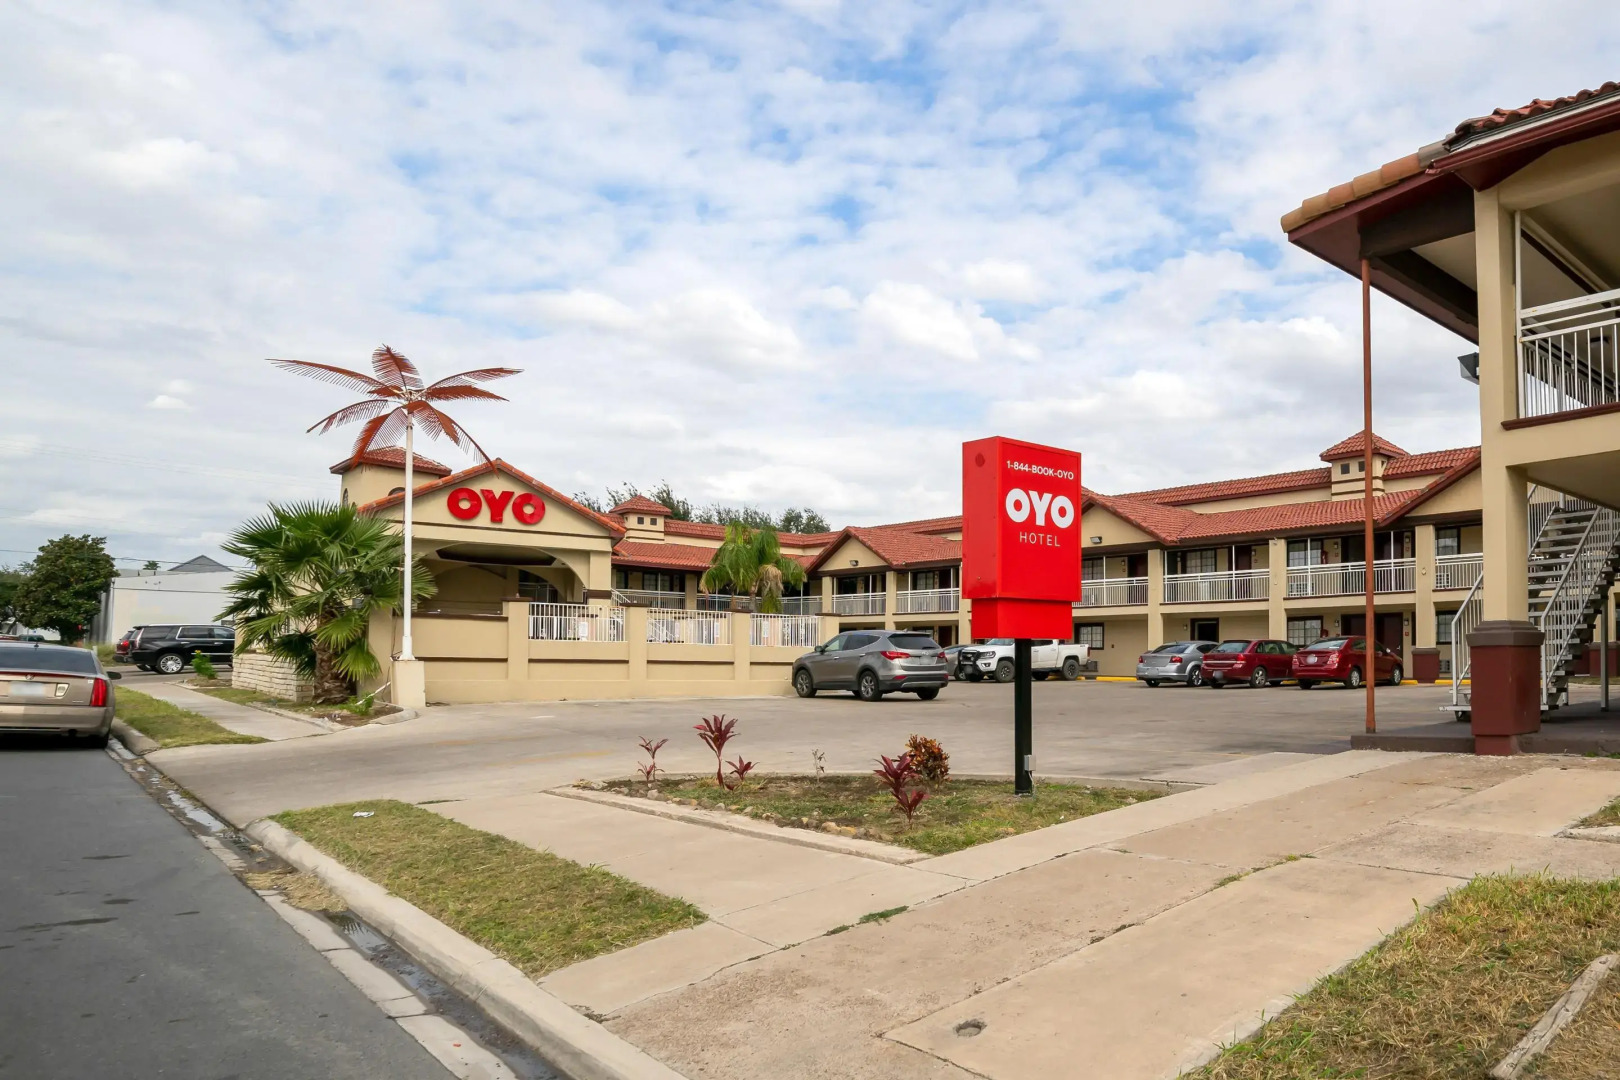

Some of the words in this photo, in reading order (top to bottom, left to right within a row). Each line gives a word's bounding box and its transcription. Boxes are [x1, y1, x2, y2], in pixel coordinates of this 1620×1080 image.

[1006, 460, 1074, 480] 1-844-BOOK-OYO
[447, 487, 546, 525] OYO
[1005, 488, 1075, 529] OYO
[1019, 531, 1060, 547] HOTEL
